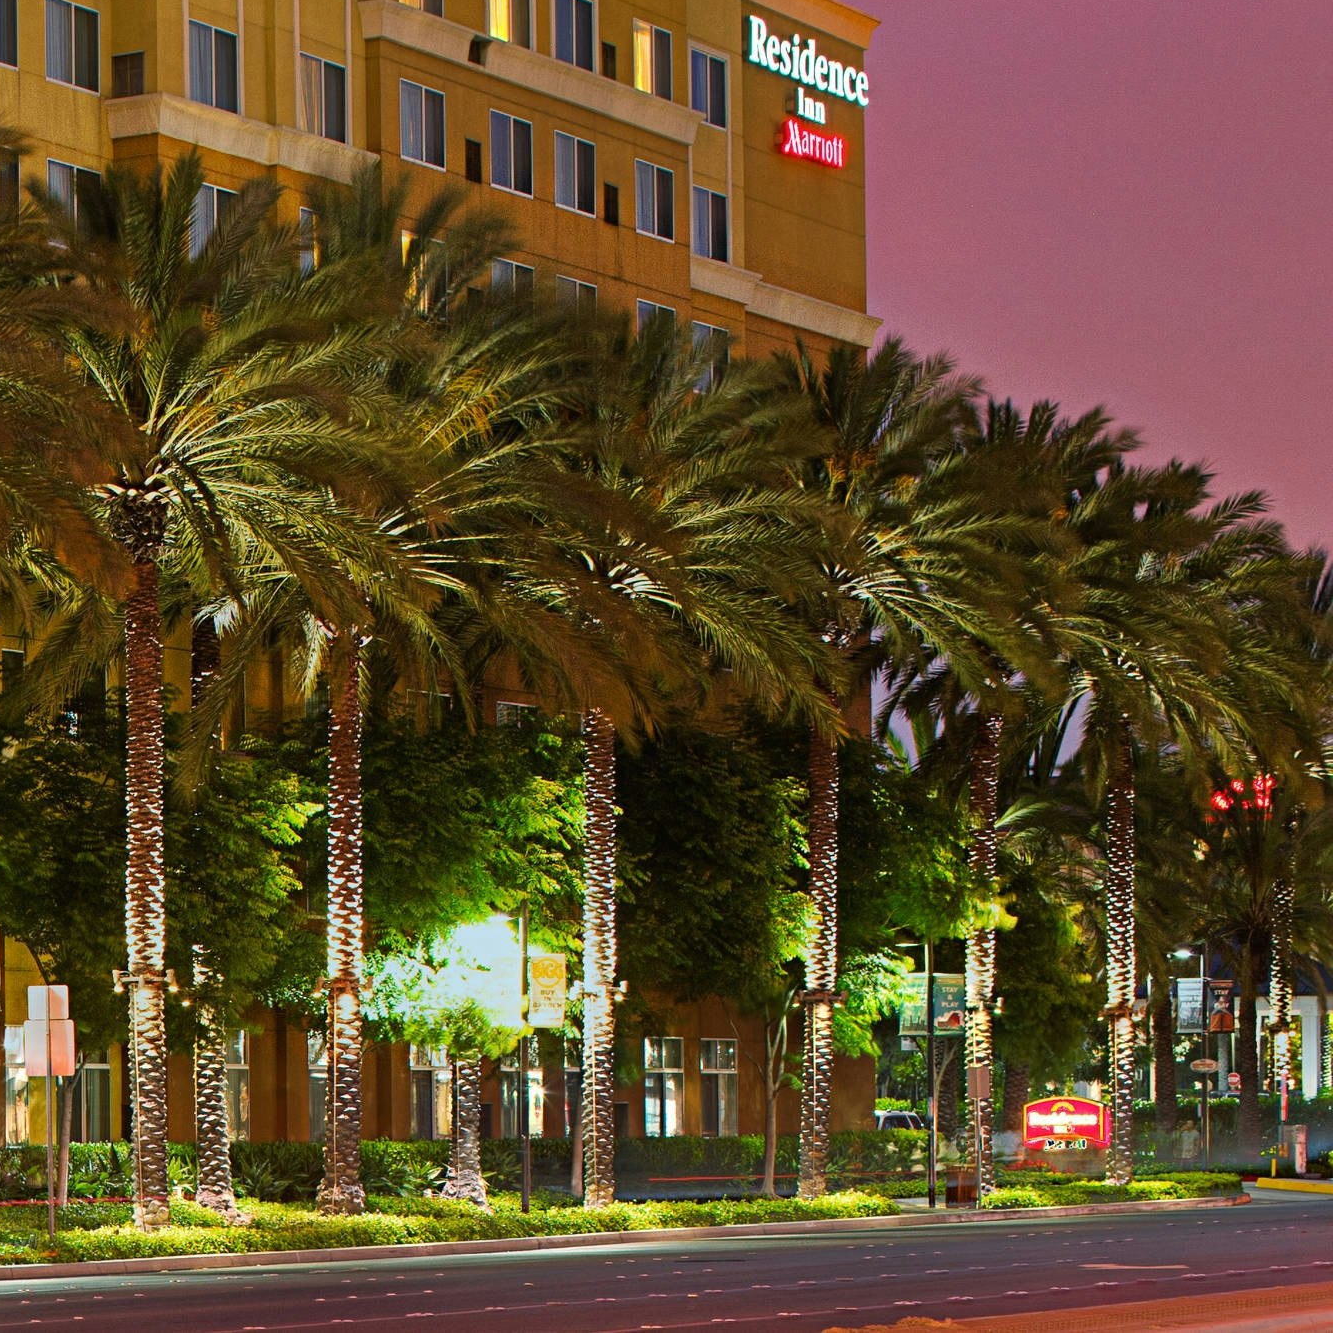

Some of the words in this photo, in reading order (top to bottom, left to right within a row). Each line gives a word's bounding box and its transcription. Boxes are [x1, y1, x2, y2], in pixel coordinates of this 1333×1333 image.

[748, 14, 870, 107] Residence
[797, 87, 826, 125] Inn
[784, 119, 844, 168] Marriott
